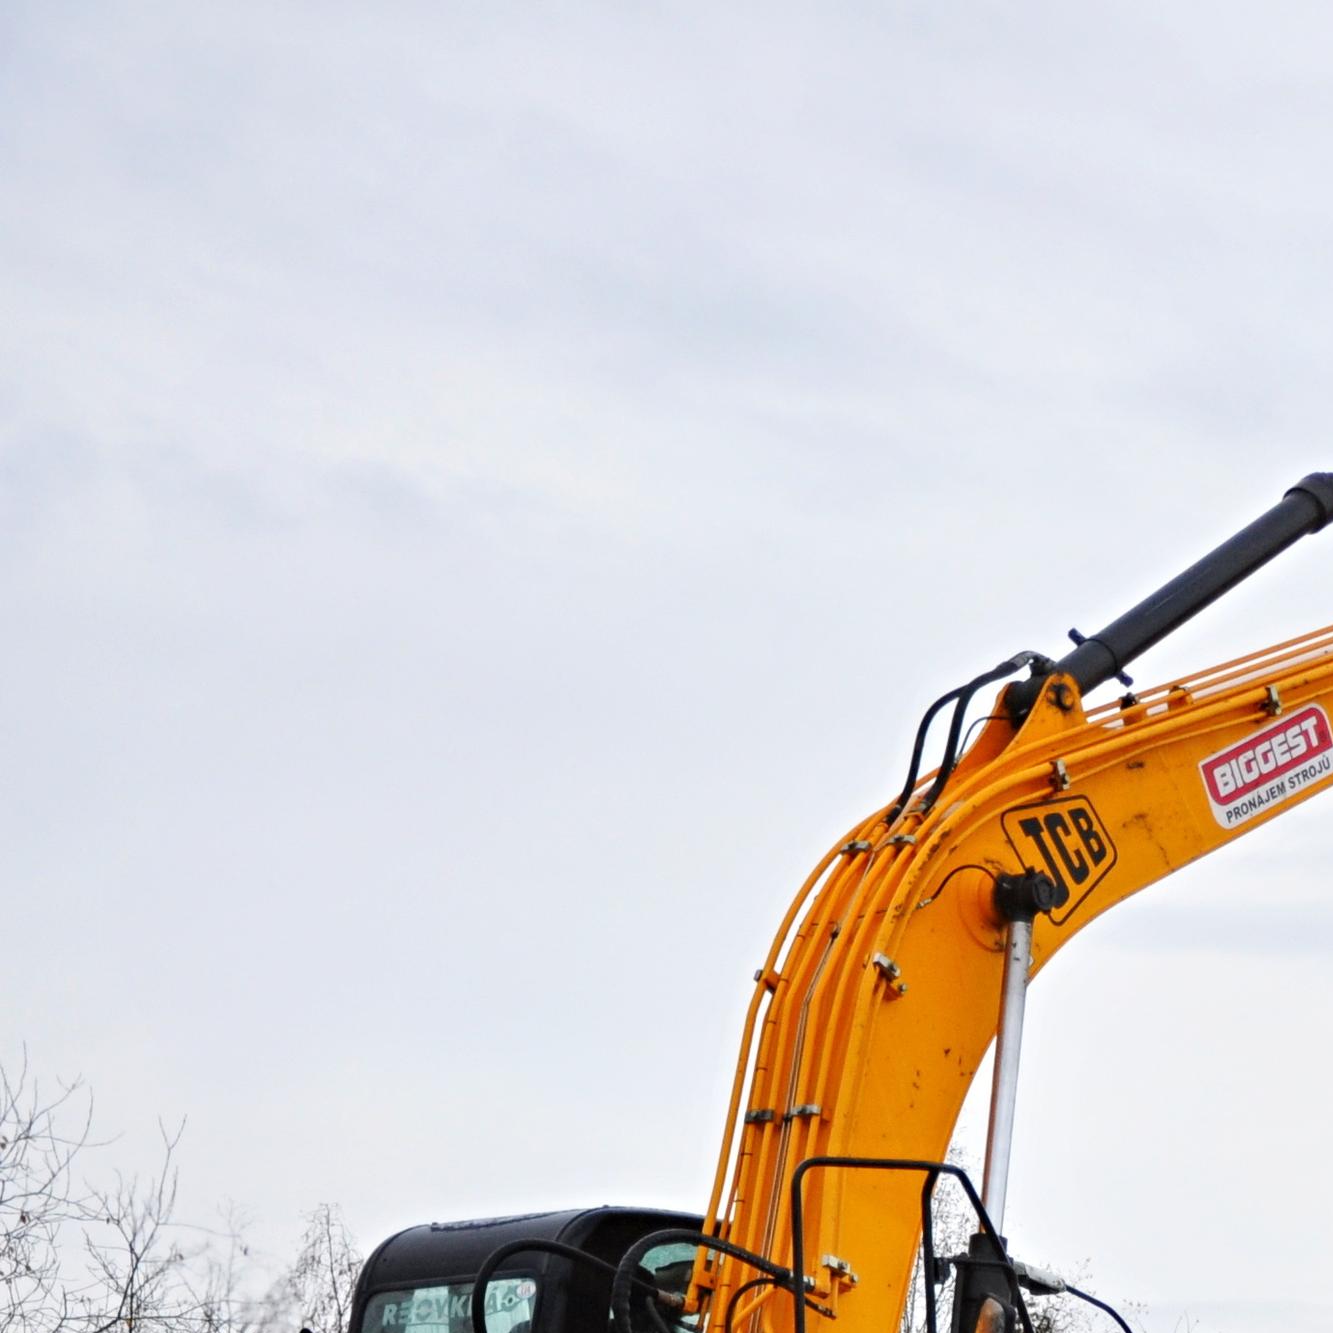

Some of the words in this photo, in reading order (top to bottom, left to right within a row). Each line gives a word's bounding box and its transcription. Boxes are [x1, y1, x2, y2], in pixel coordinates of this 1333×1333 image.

[1213, 716, 1318, 798] BIGGEST
[1226, 781, 1287, 823] PRONÁJEM
[1288, 755, 1331, 789] STROJŮ
[1018, 807, 1107, 909] JCB
